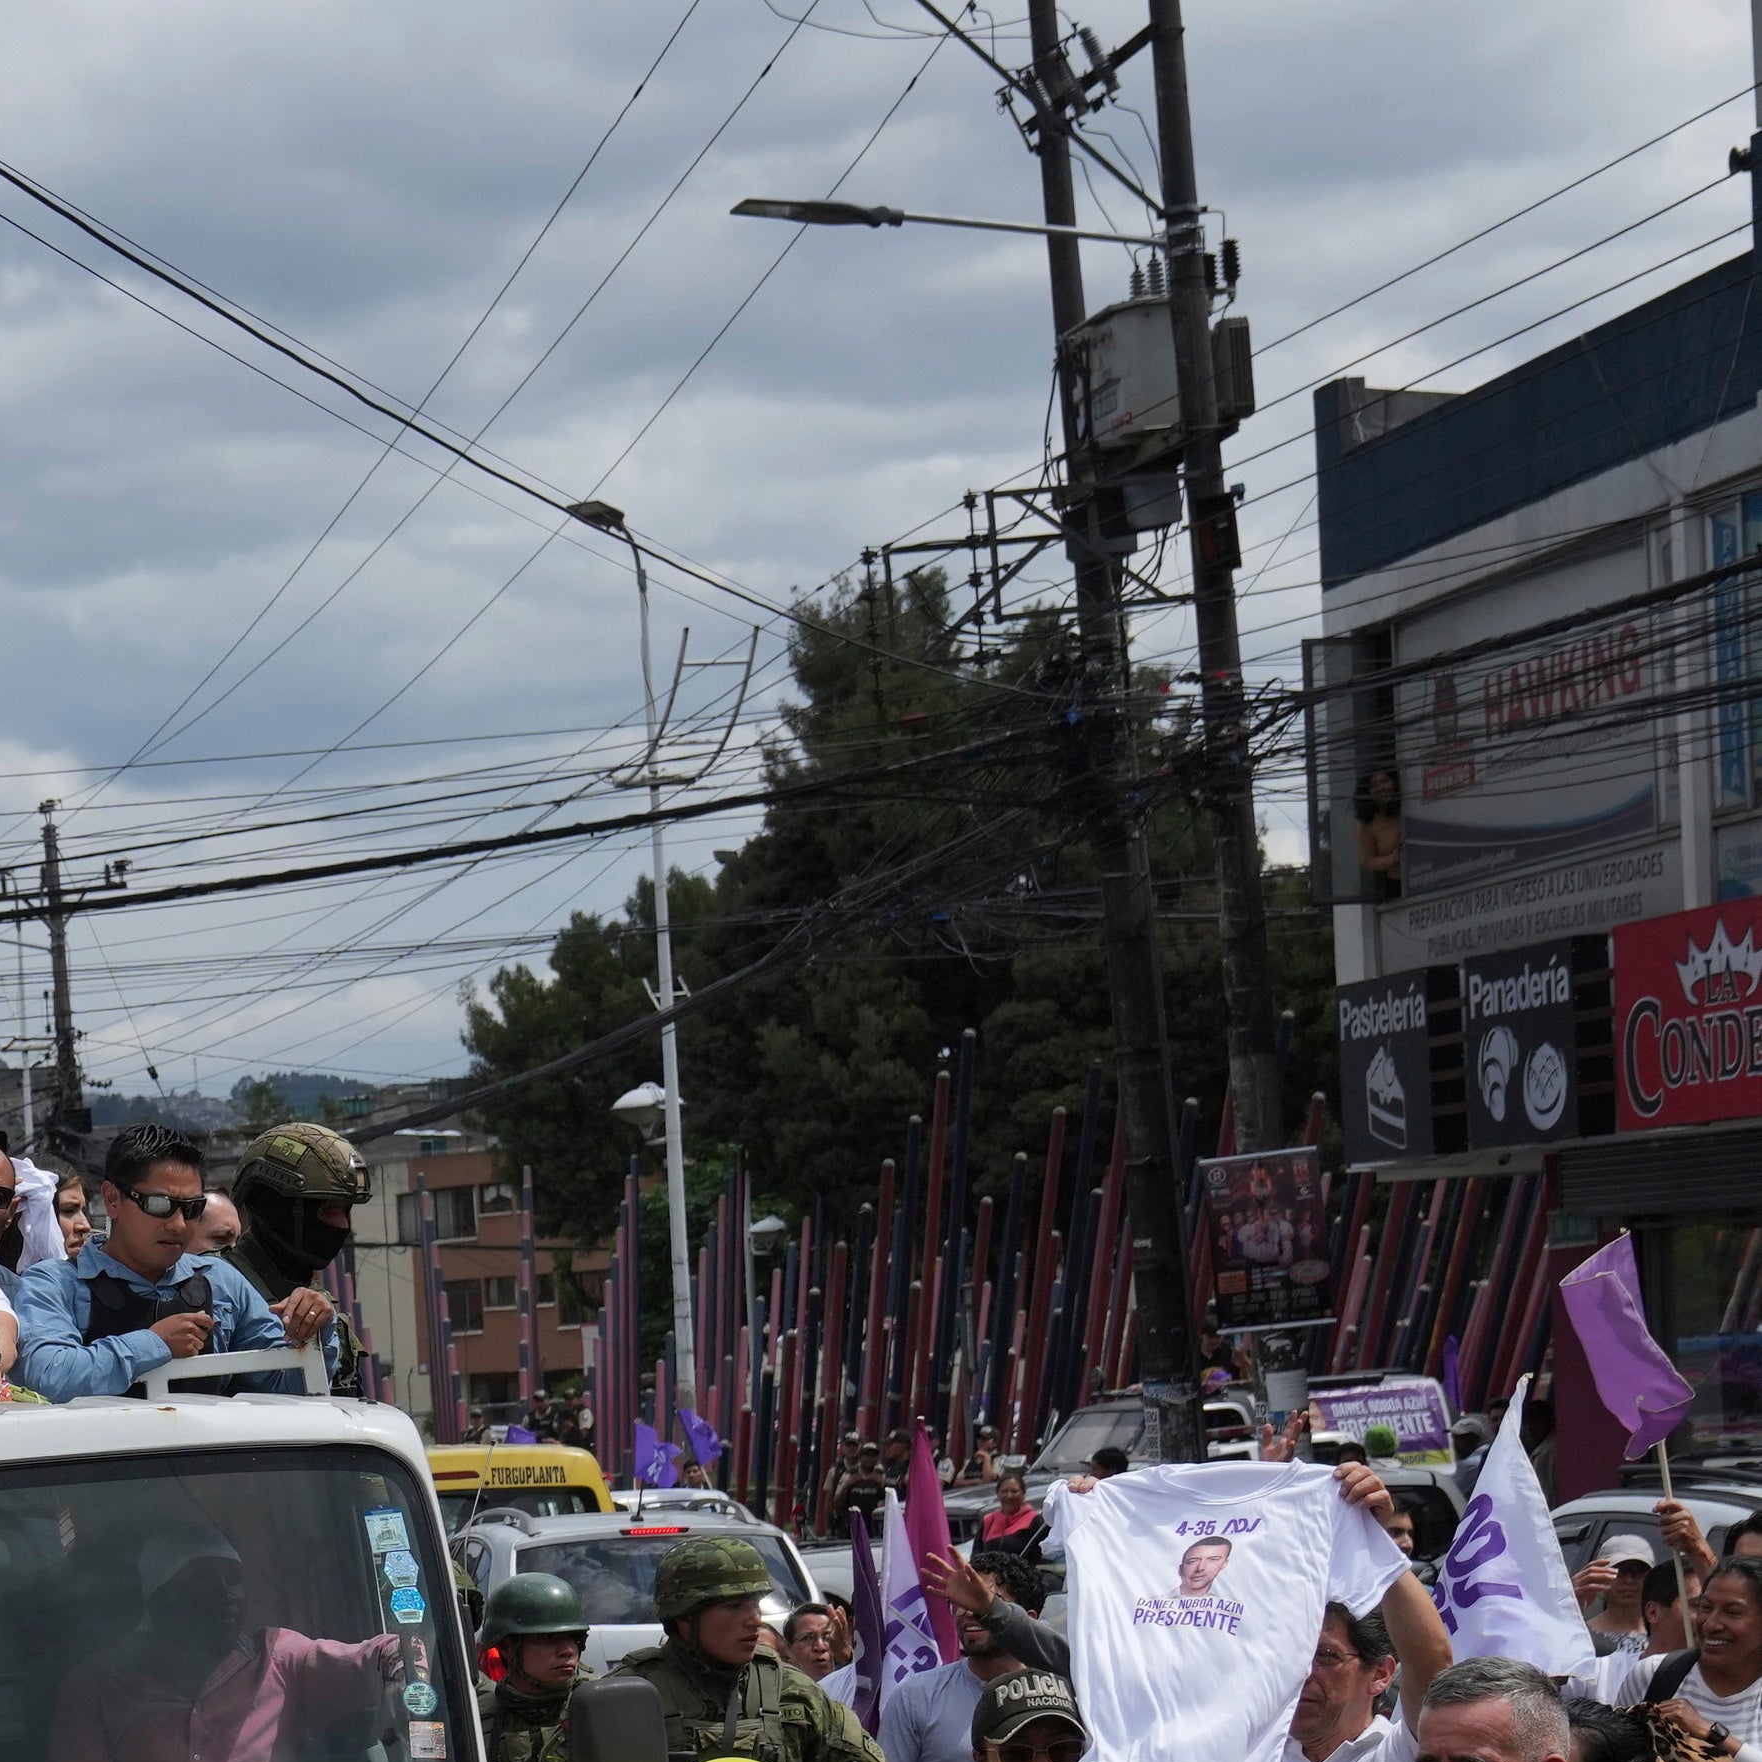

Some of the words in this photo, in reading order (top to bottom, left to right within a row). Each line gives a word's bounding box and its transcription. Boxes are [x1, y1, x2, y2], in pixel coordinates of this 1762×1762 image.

[1483, 625, 1641, 738] HAWKING
[1468, 952, 1571, 1020] Panadería
[1704, 955, 1740, 1006] LA
[1339, 983, 1426, 1042] Pastelería
[1330, 1399, 1367, 1418] DANIEL
[1175, 1520, 1217, 1536] 4-35
[1133, 1607, 1242, 1636] PRESIDENTE
[1137, 1597, 1176, 1610] DANIEL
[1178, 1597, 1214, 1611] NOBOA
[1216, 1598, 1244, 1615] AZIN
